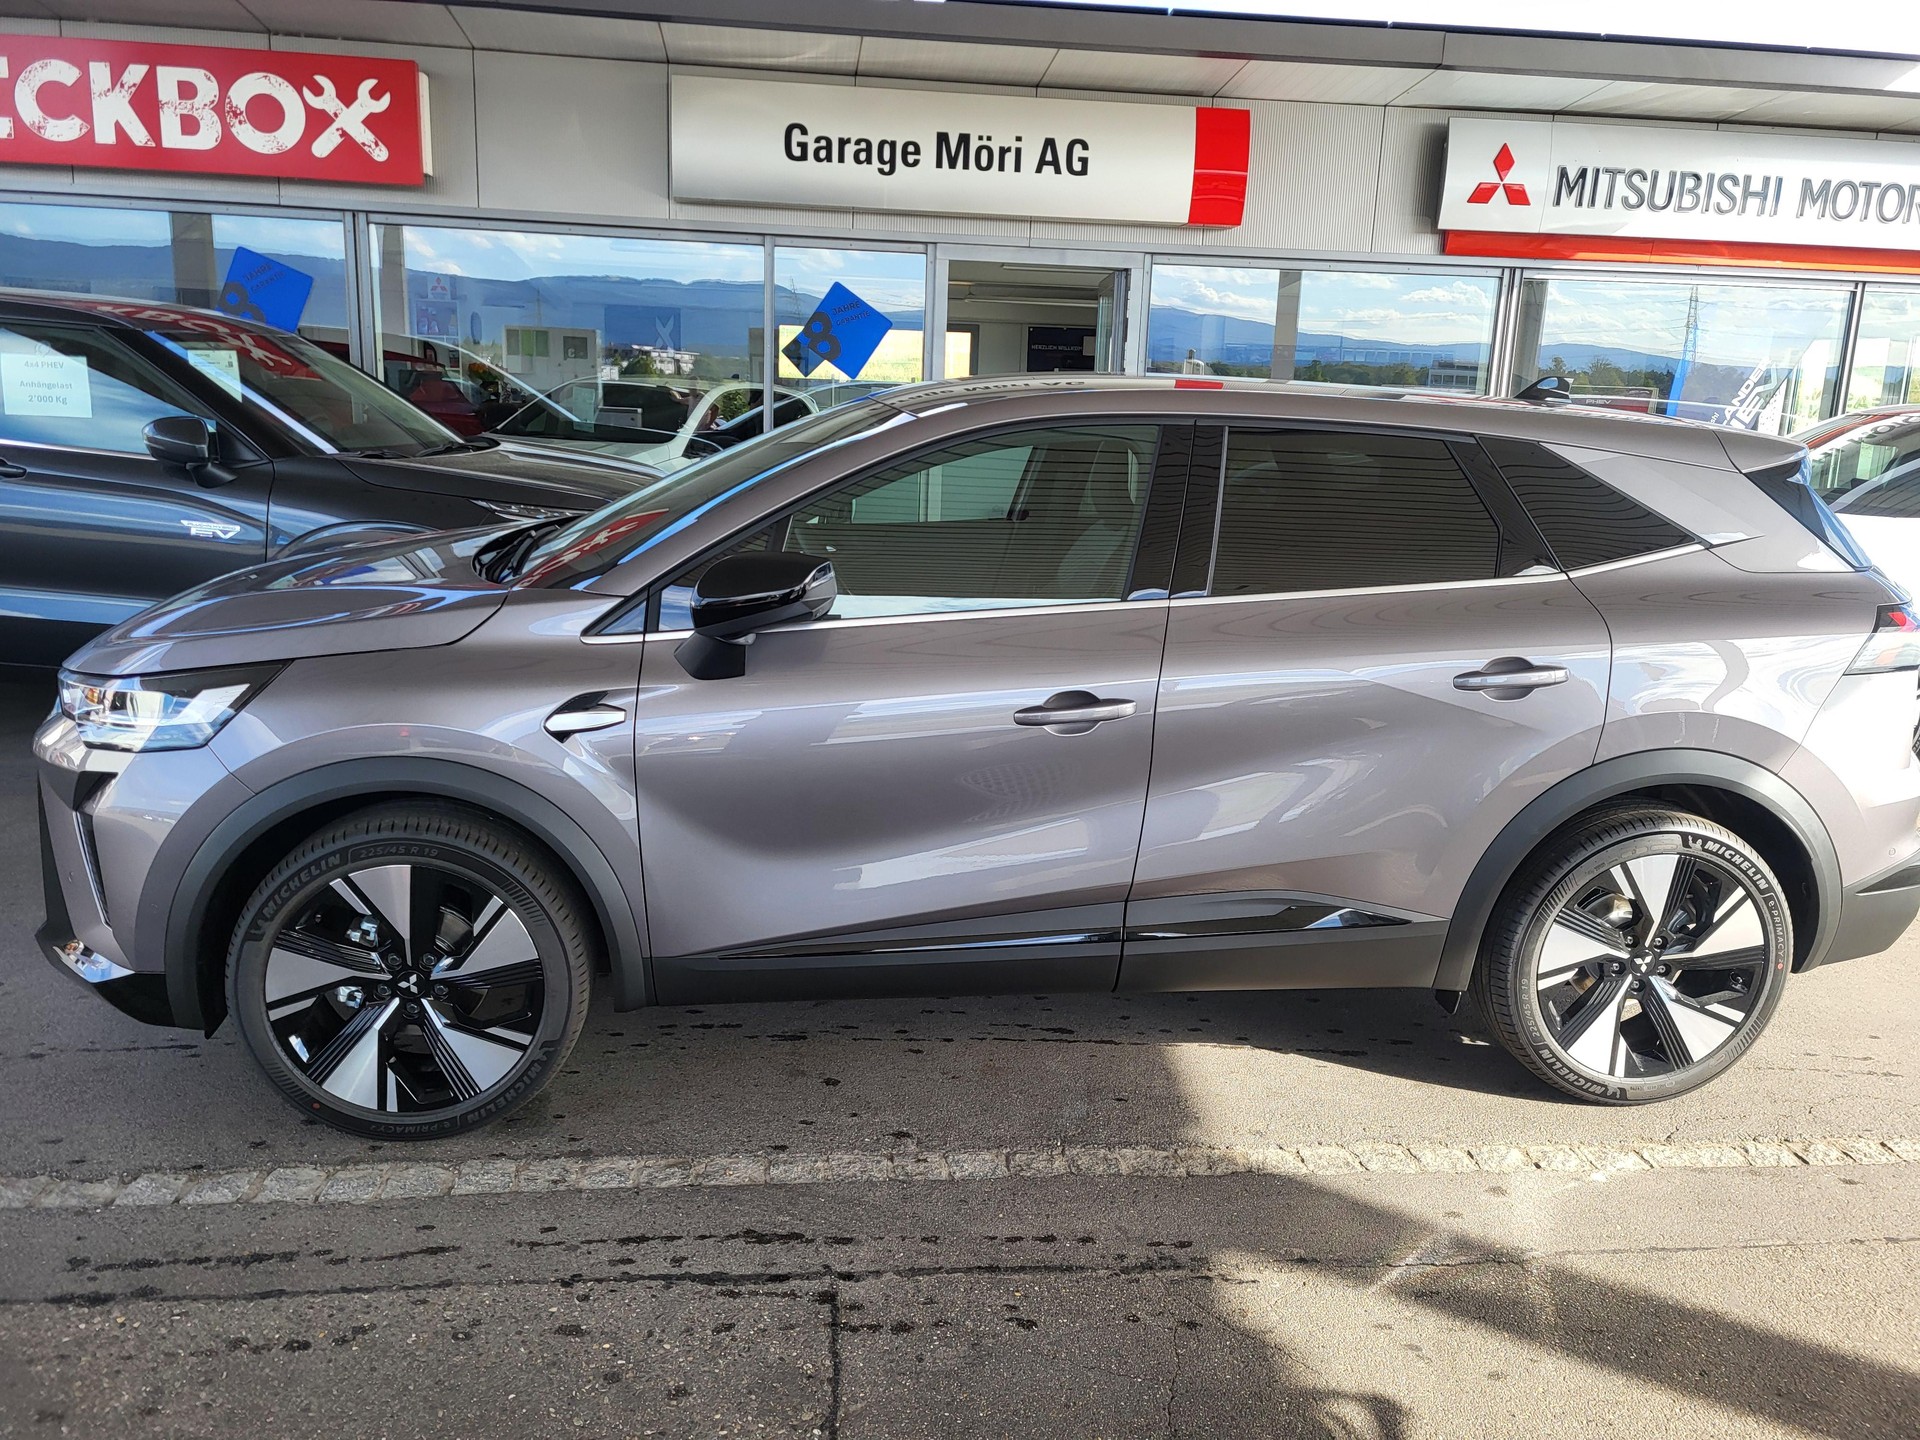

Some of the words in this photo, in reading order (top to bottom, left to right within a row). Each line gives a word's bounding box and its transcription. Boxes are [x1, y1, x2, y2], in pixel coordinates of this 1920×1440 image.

[784, 123, 921, 176] Garage
[935, 131, 1023, 173] Möri
[1034, 137, 1090, 176] AG
[1552, 164, 1784, 218] MITSUBISHI
[831, 300, 861, 315] JAHRE
[803, 311, 842, 361] 8
[24, 360, 39, 368] 4x4
[41, 361, 64, 369] PHEV
[19, 380, 73, 391] Anhängelast
[55, 395, 68, 405] Kg
[360, 846, 406, 858] 225/45
[410, 846, 419, 854] R
[424, 847, 438, 857] 19
[1704, 840, 1769, 890] MICHELIN
[262, 853, 342, 919] MICHELIN
[1521, 978, 1528, 990] 19
[1522, 1003, 1540, 1038] 225/45
[1539, 1048, 1606, 1094] MICHELIN
[467, 1062, 543, 1124] MICHELIN
